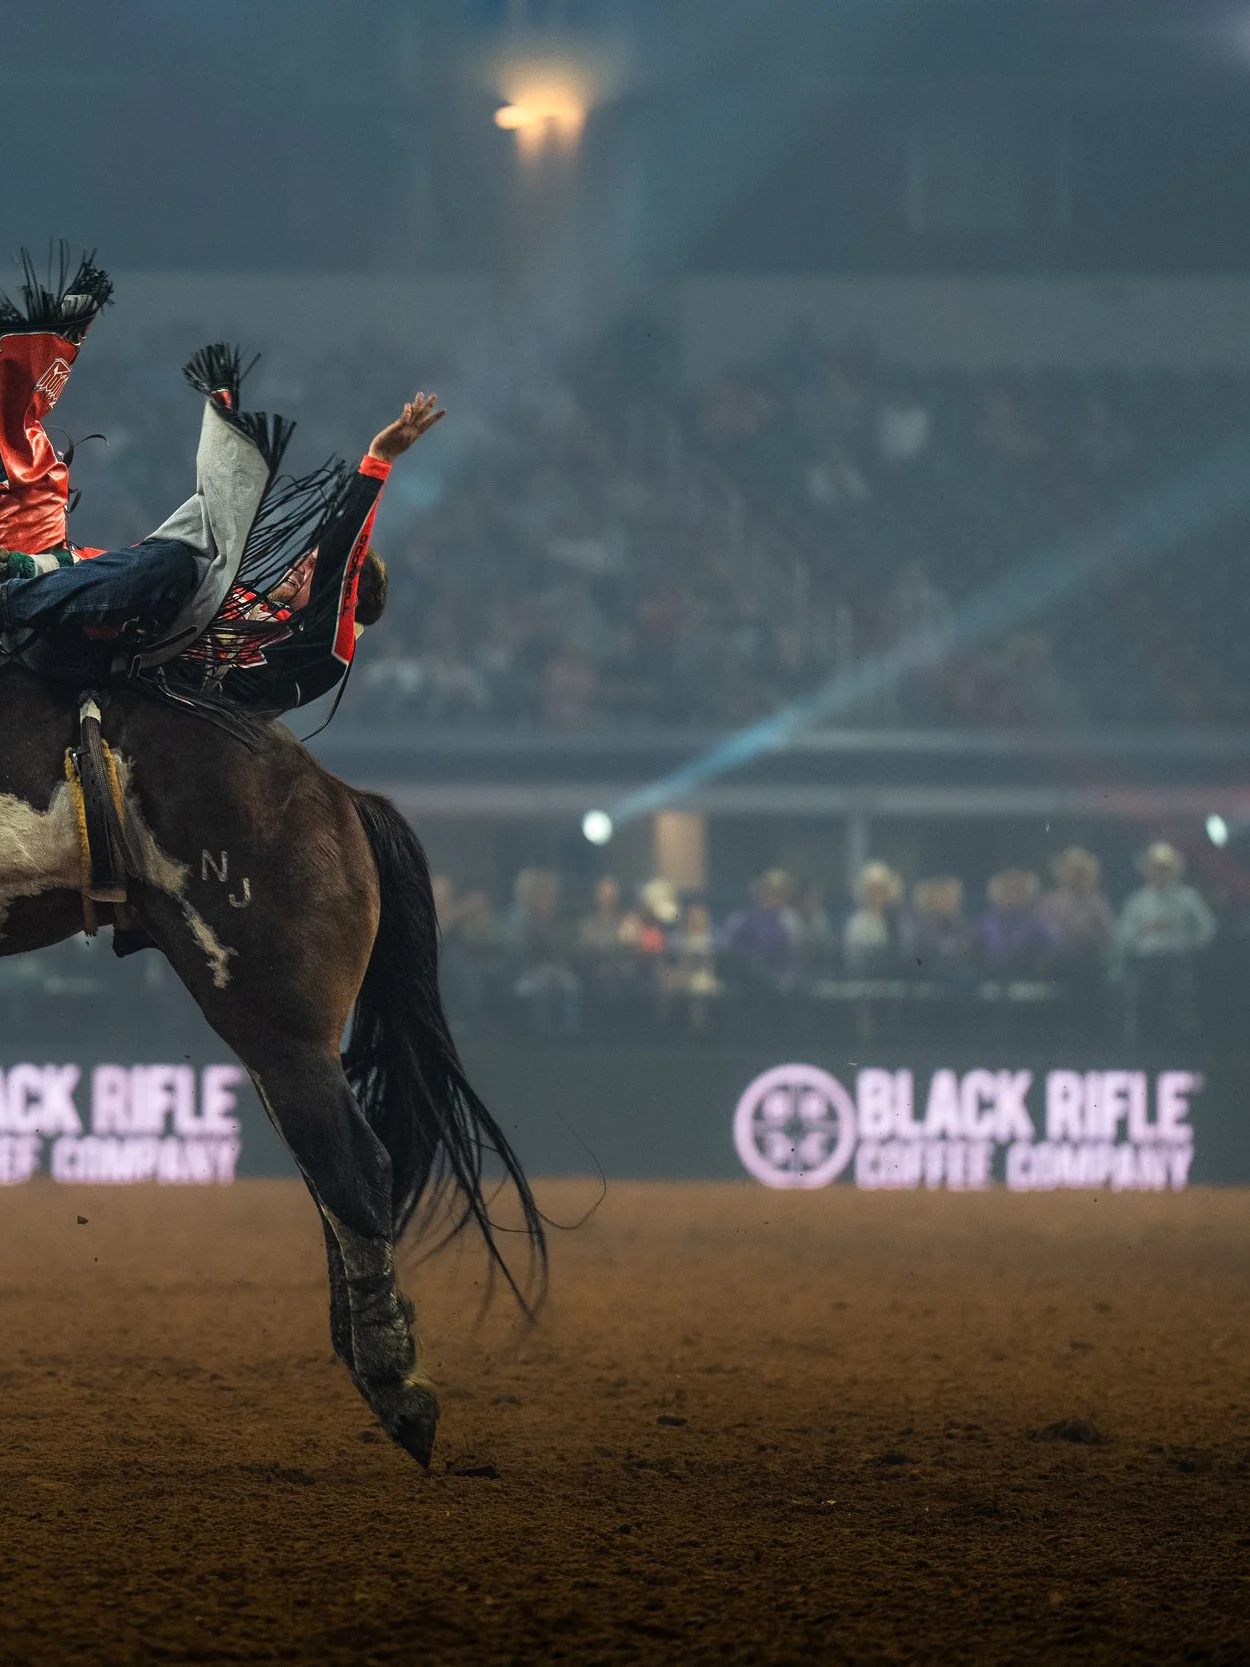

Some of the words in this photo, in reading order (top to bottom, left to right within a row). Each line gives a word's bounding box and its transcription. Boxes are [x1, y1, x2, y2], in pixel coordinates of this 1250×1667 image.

[92, 1064, 242, 1135] RIFLE
[857, 1068, 1035, 1141] BLACK
[1047, 1070, 1193, 1141] RIFLE
